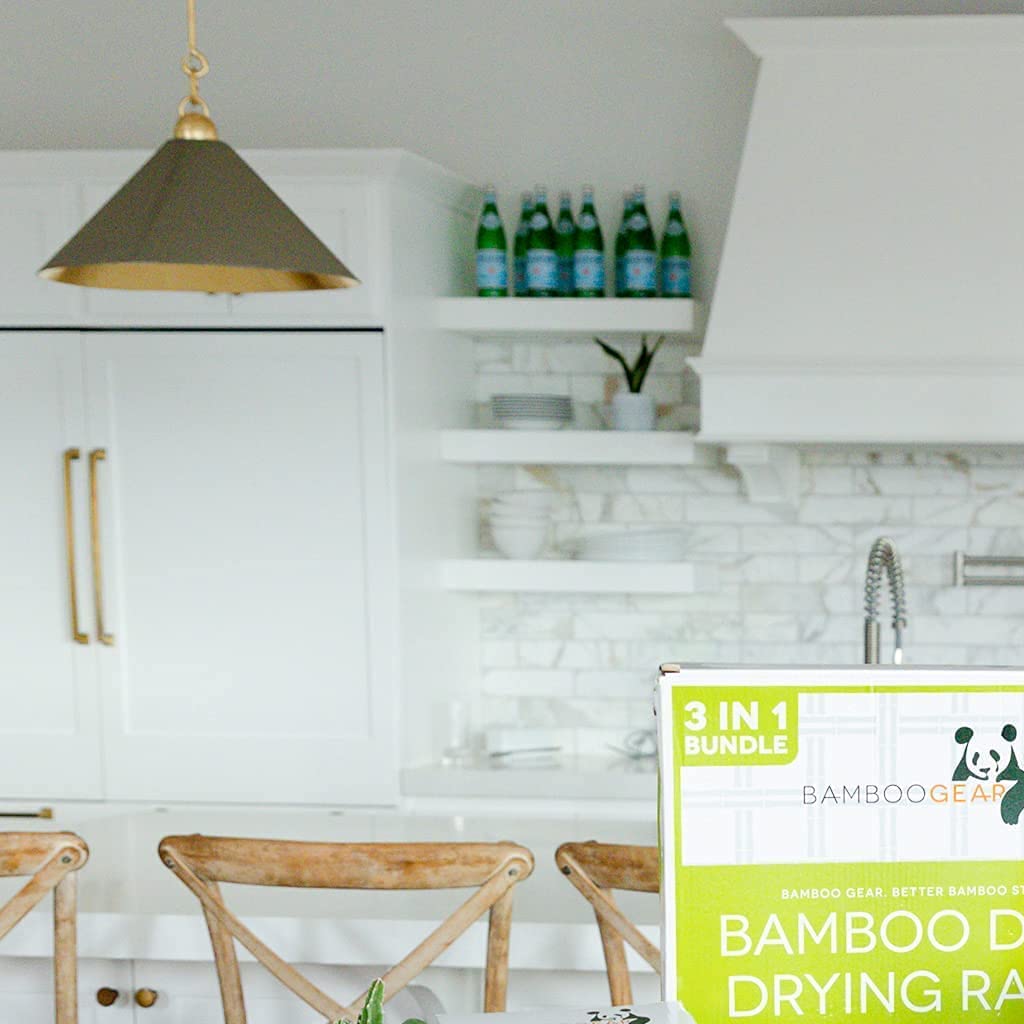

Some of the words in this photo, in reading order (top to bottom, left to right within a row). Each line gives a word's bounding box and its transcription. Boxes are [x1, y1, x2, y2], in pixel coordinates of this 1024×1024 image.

[684, 700, 707, 731] 3
[719, 701, 759, 731] IN
[771, 701, 787, 730] 1
[684, 735, 788, 755] BUNDLE
[781, 888, 841, 900] BAMBOO
[846, 887, 887, 898] GEAR.
[892, 886, 943, 897] BETTER
[949, 885, 1007, 897] BAMBOO
[720, 909, 971, 957] BAMBOO
[728, 970, 941, 1018] DRYING
